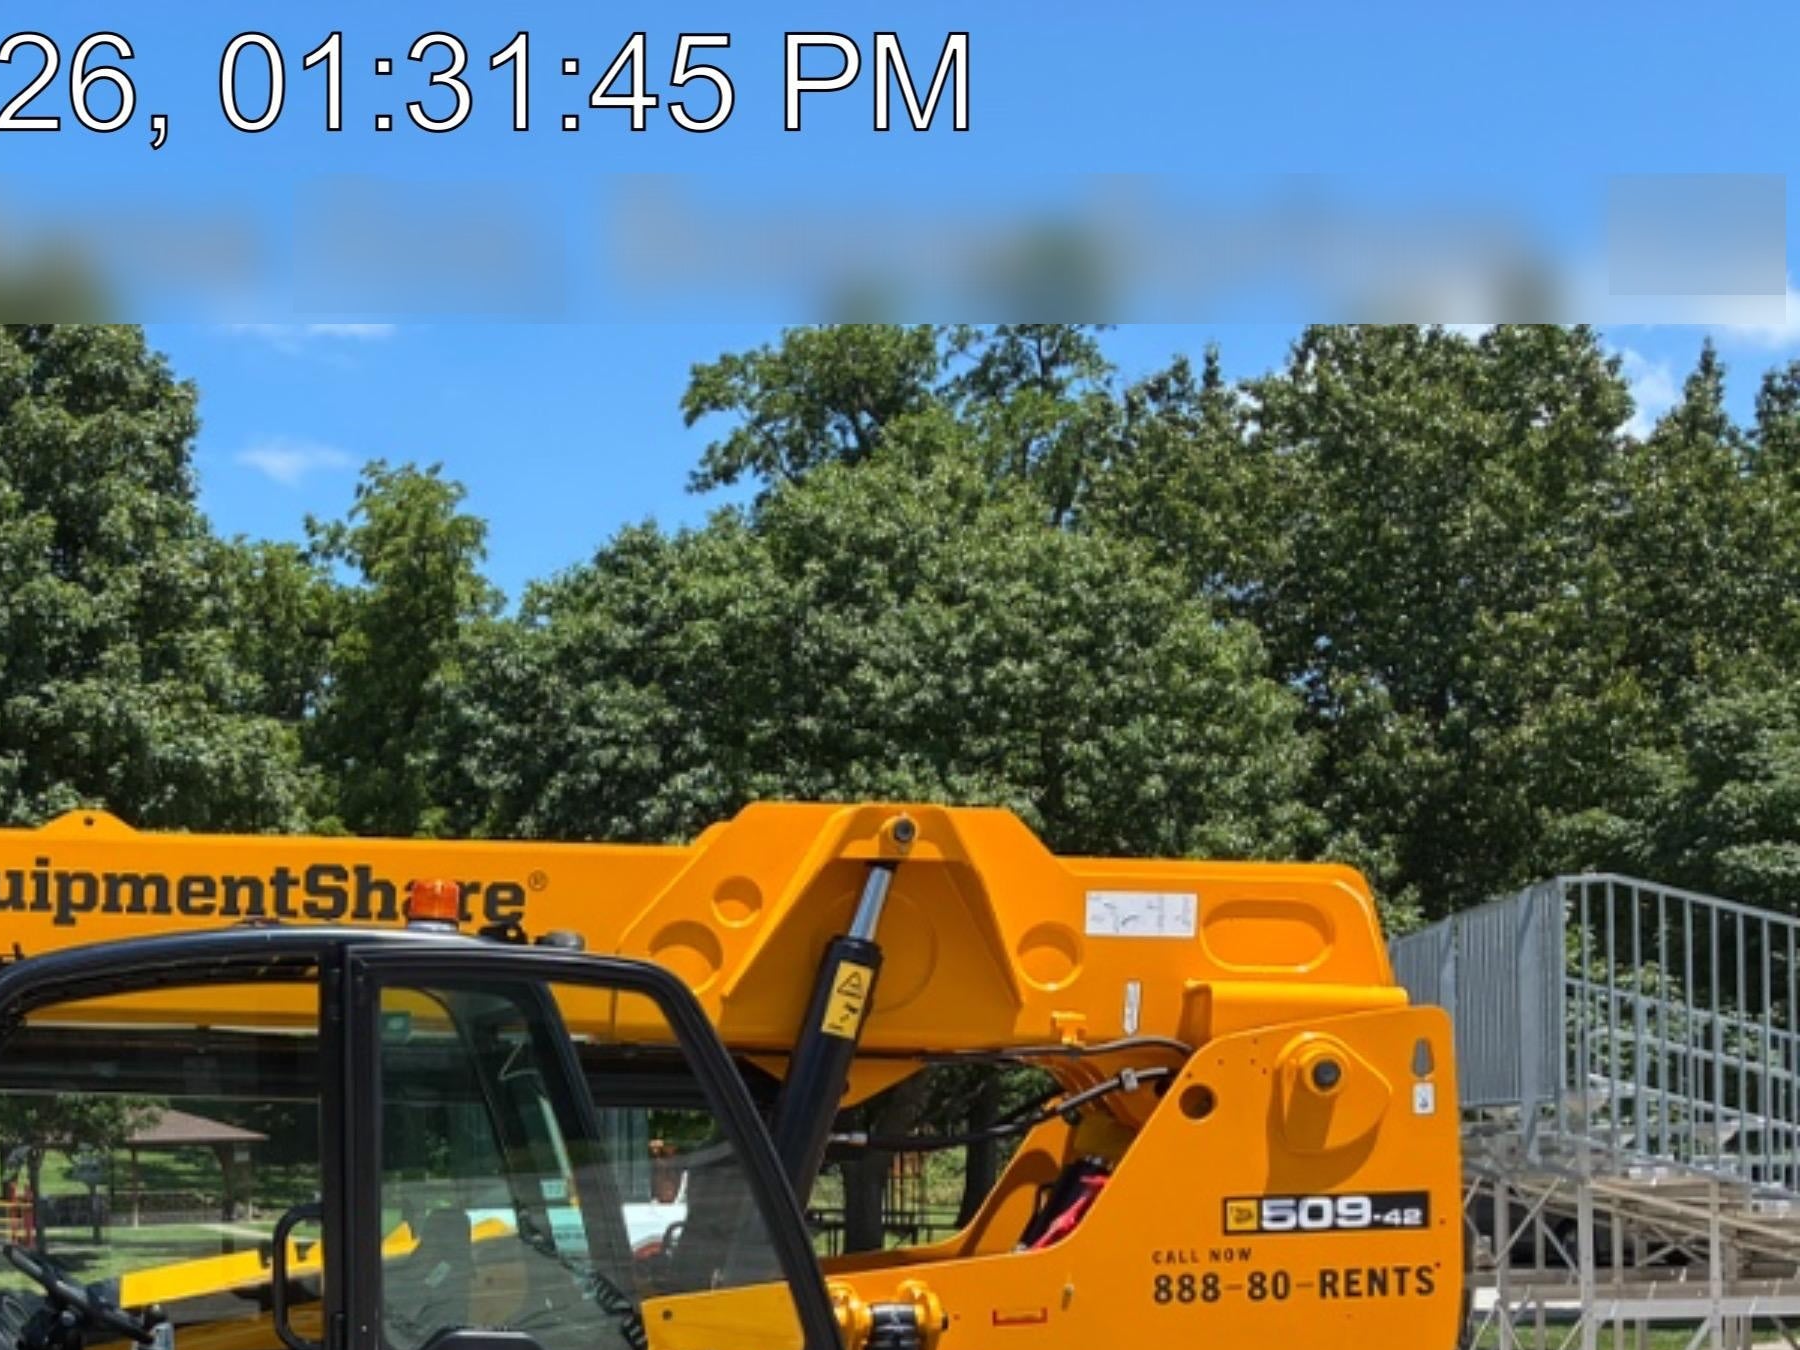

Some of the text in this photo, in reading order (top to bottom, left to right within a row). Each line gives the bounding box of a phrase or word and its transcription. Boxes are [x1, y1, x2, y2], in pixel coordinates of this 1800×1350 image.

[1261, 1195, 1423, 1231] 509-42
[1151, 1247, 1252, 1265] CALL NOW
